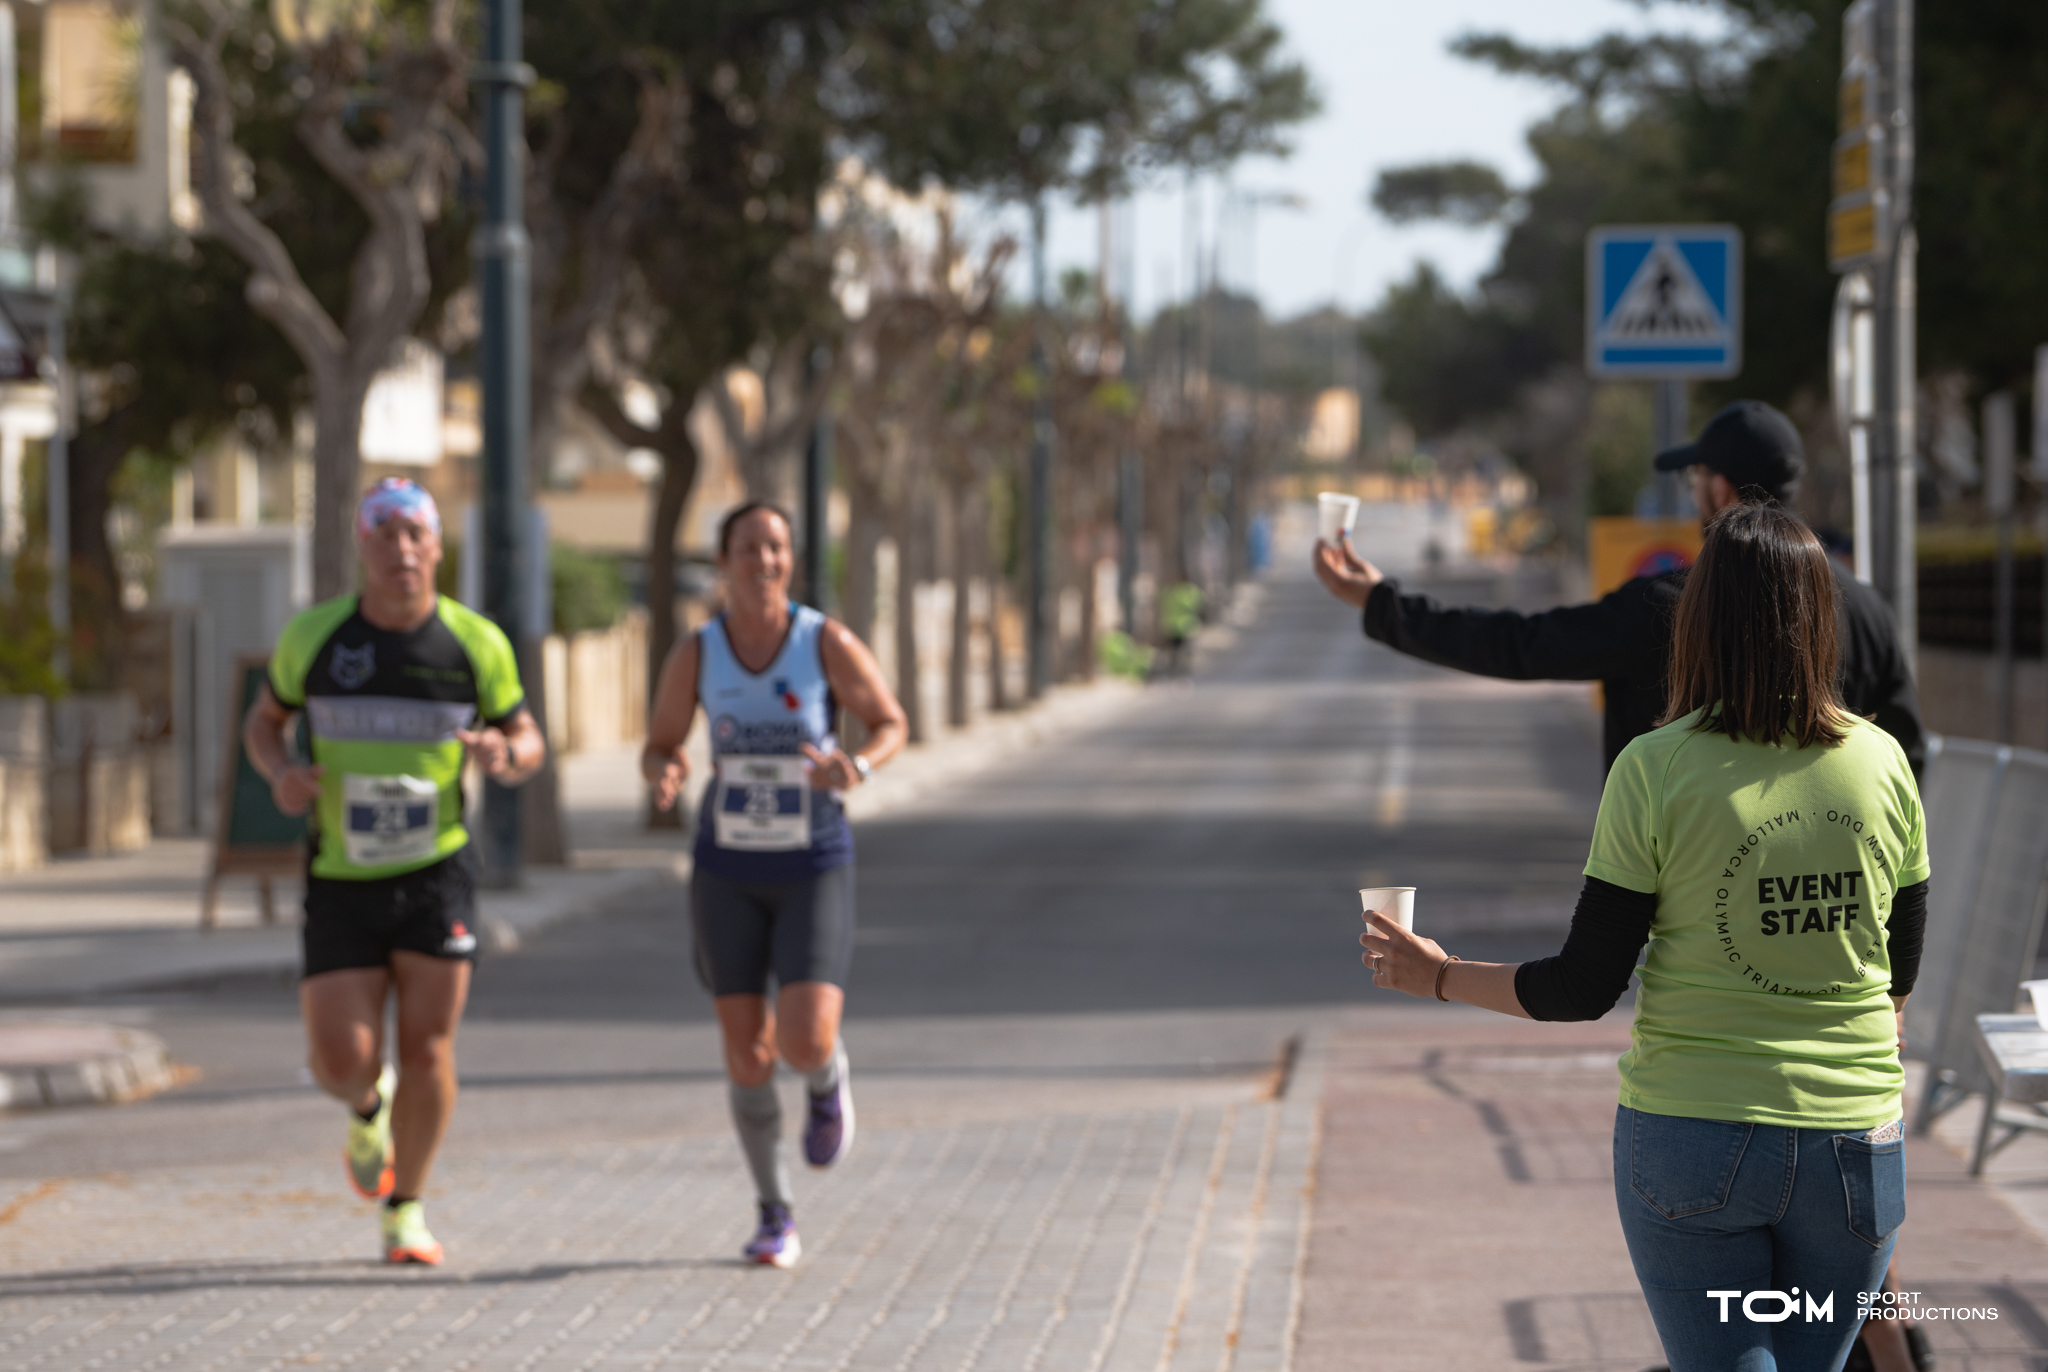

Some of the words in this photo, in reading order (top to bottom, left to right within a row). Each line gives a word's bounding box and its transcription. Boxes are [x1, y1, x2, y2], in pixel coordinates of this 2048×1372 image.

[1826, 810, 1865, 834] DUO
[1722, 809, 1800, 879] MALLORCA
[1758, 871, 1863, 904] EVENT
[1715, 888, 1741, 963] OLYMPIC
[1760, 904, 1860, 936] STAFF
[1857, 939, 1882, 978] BEST
